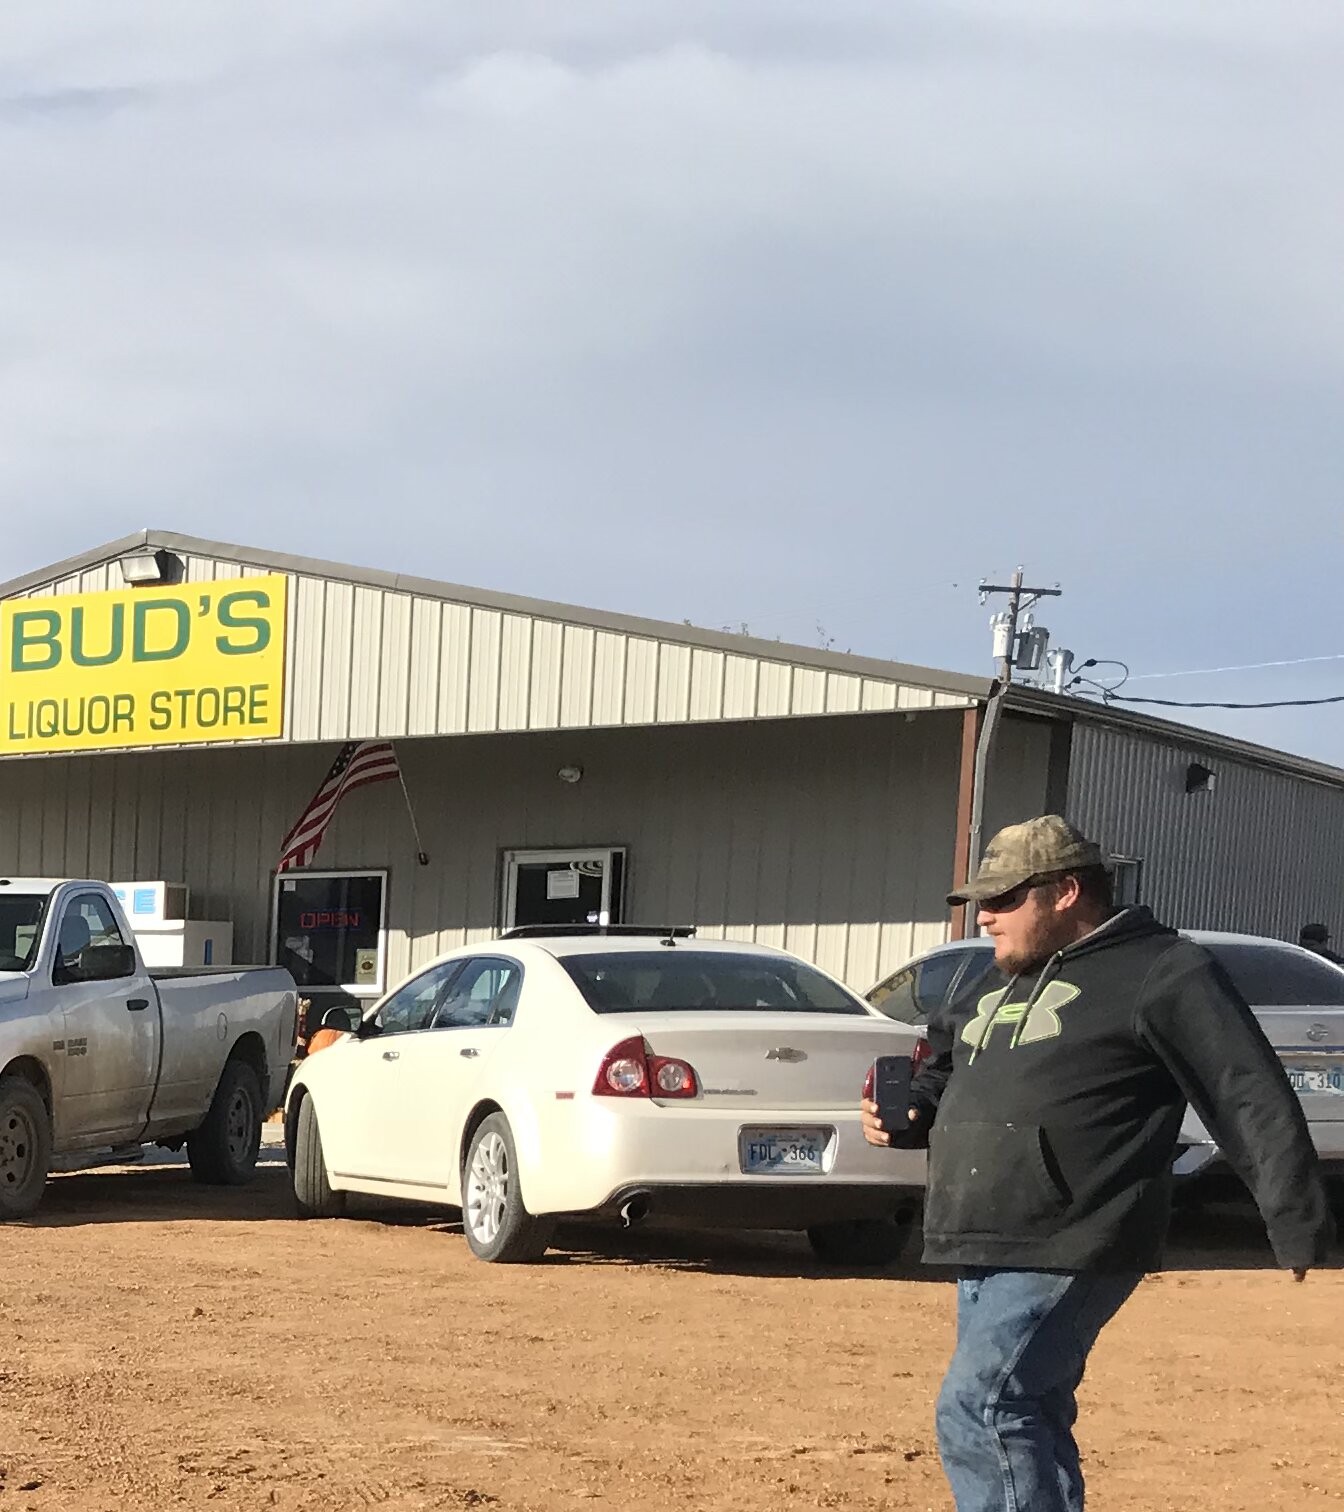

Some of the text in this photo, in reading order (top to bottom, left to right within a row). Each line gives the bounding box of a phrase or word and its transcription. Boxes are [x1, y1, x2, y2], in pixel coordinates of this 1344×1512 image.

[11, 590, 272, 673] BUD'S
[8, 683, 270, 741] LIQUOR STORE
[300, 911, 361, 929] OPEN
